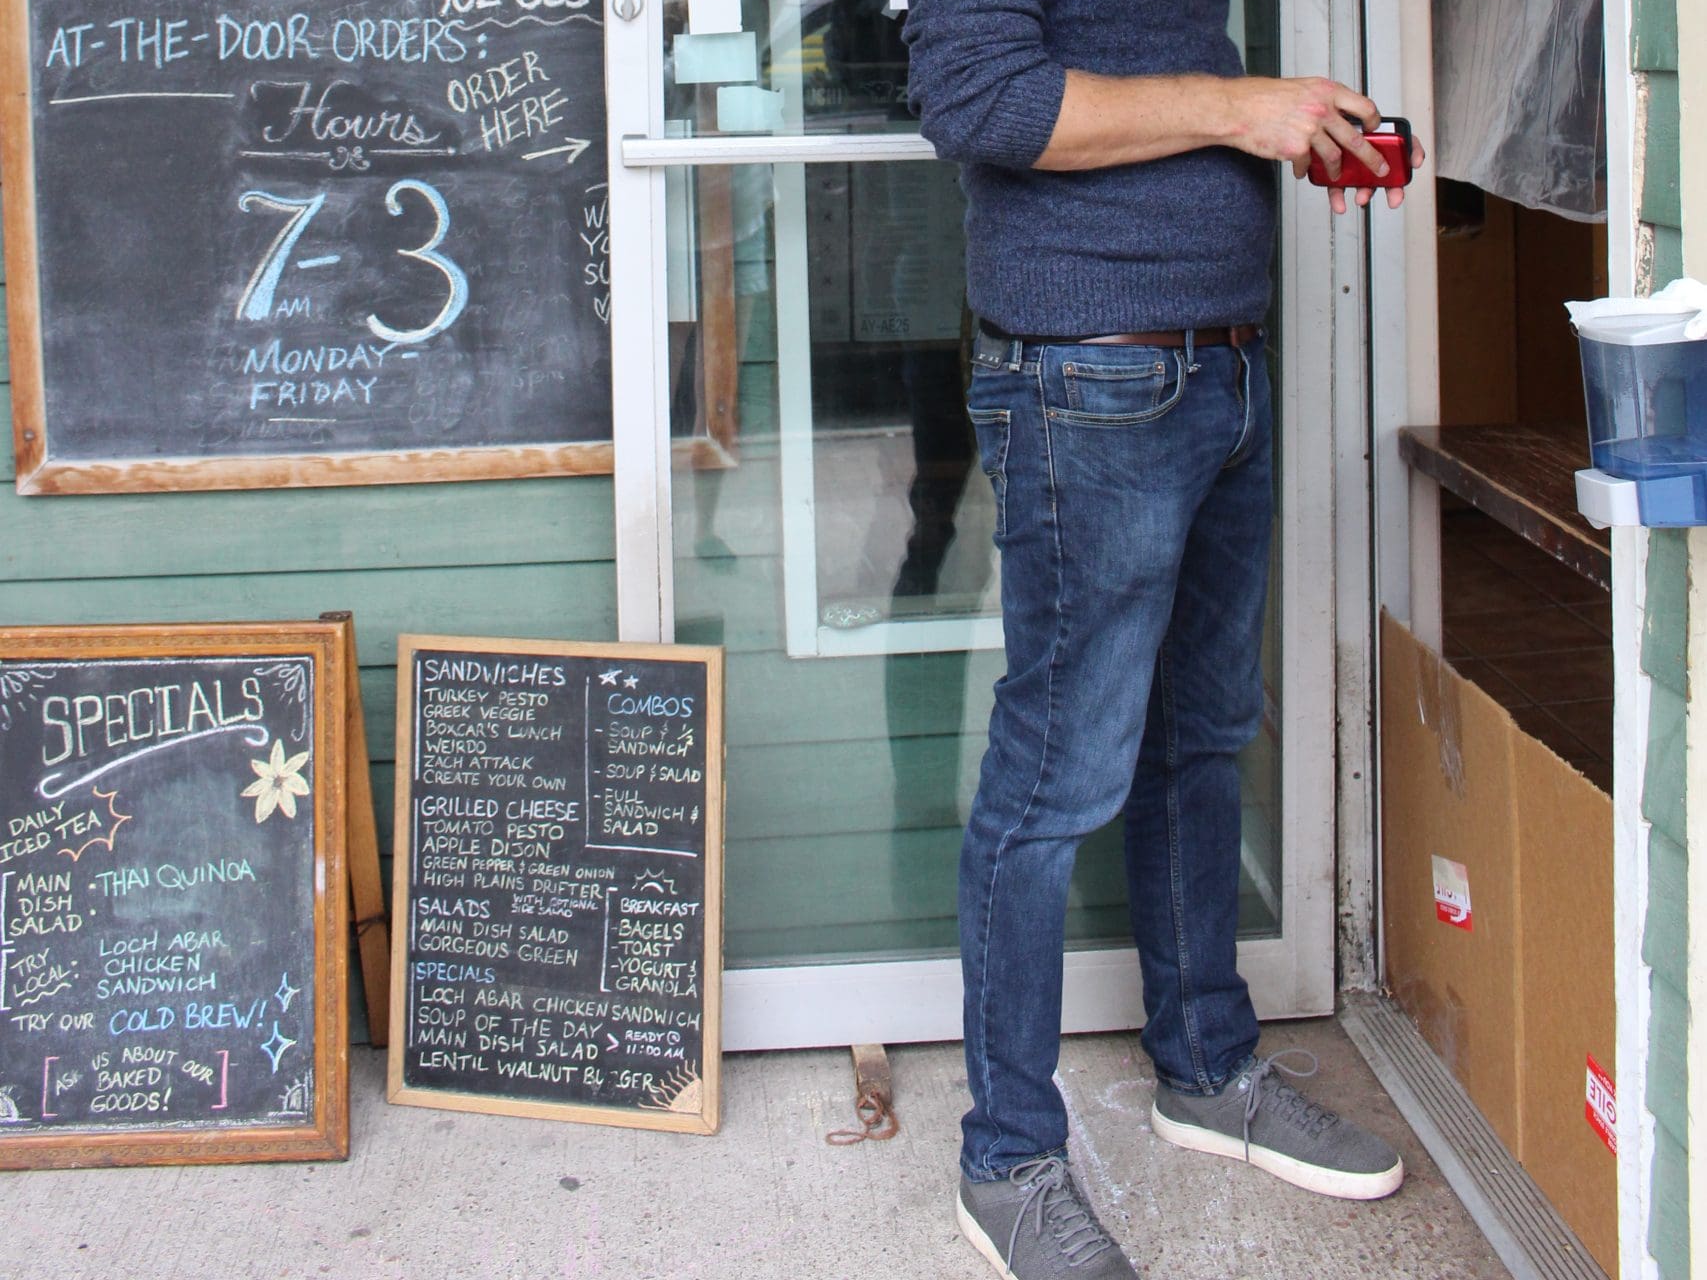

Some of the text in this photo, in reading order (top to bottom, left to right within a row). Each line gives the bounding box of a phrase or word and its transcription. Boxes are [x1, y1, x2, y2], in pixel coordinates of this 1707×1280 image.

[332, 19, 487, 64] ORDERS:
[448, 50, 551, 113] ORDER
[251, 80, 441, 145] Hours
[480, 89, 568, 151] HERE
[275, 299, 311, 318] AM
[250, 377, 377, 410] FRIDAY
[425, 660, 566, 686] SANDWICHES
[424, 687, 549, 706] TURKEY PESTO
[608, 693, 694, 718] COMBOS
[42, 677, 264, 766] SPECIALS
[423, 705, 536, 721] GREEK VEGGIE
[425, 720, 563, 741] BOXCAR'S LUNCH
[609, 722, 653, 739] SOUP
[426, 740, 487, 754] WEIRDO
[608, 740, 688, 758] SANDWICH
[423, 755, 535, 770] ZACH ATTACK
[606, 763, 702, 783] SOUP SALAD
[423, 770, 567, 791] CREATE YOUR OWN
[605, 788, 644, 804] FULL
[8, 801, 65, 836] DAILY
[420, 796, 580, 822] GRILLED CHEESE
[604, 801, 685, 820] SANDWICH
[0, 809, 101, 863] ICED TEA
[423, 820, 564, 840] TOMATO PESTO
[603, 819, 659, 836] SALAD
[422, 836, 550, 859] APPLE DIJON
[95, 859, 256, 897] THAI QUINOA
[423, 855, 615, 880] GREEN PEPPER GREEN ONION
[17, 872, 71, 895] MAIN
[424, 870, 603, 899] HIGH PLAINS DRIFTER
[18, 894, 72, 917] DISH
[418, 897, 490, 919] SALADS
[513, 893, 543, 906] WITH
[620, 897, 699, 917] BREAKFAST
[9, 914, 82, 936] SALAD
[420, 919, 569, 944] MAIN DISH SALAD
[100, 929, 228, 957] LOCH ABAR
[418, 934, 578, 966] GORGEOUS GREEN
[10, 948, 49, 977] TRY
[105, 953, 201, 976] CHICKEN
[415, 962, 495, 983] SPECIALS
[97, 972, 216, 1000] SANDWICH
[615, 976, 697, 998] GRANOLA
[10, 1000, 268, 1035] TRY OUR COLD BREW!
[420, 985, 700, 1031] LOCH ABAR CHICKEN SANDWICH
[418, 1006, 603, 1039] SOUP OF THE DAY
[418, 1029, 598, 1060] MAIN DISH SALAD
[625, 1030, 680, 1045] READY @
[664, 1047, 685, 1060] AM
[92, 1052, 110, 1071] US
[122, 1047, 179, 1066] ABOUT
[182, 1060, 213, 1086] OUR
[419, 1052, 659, 1093] LENTIL WALNUT BUGER
[97, 1067, 161, 1092] BAKED
[90, 1087, 172, 1112] GOODS!
